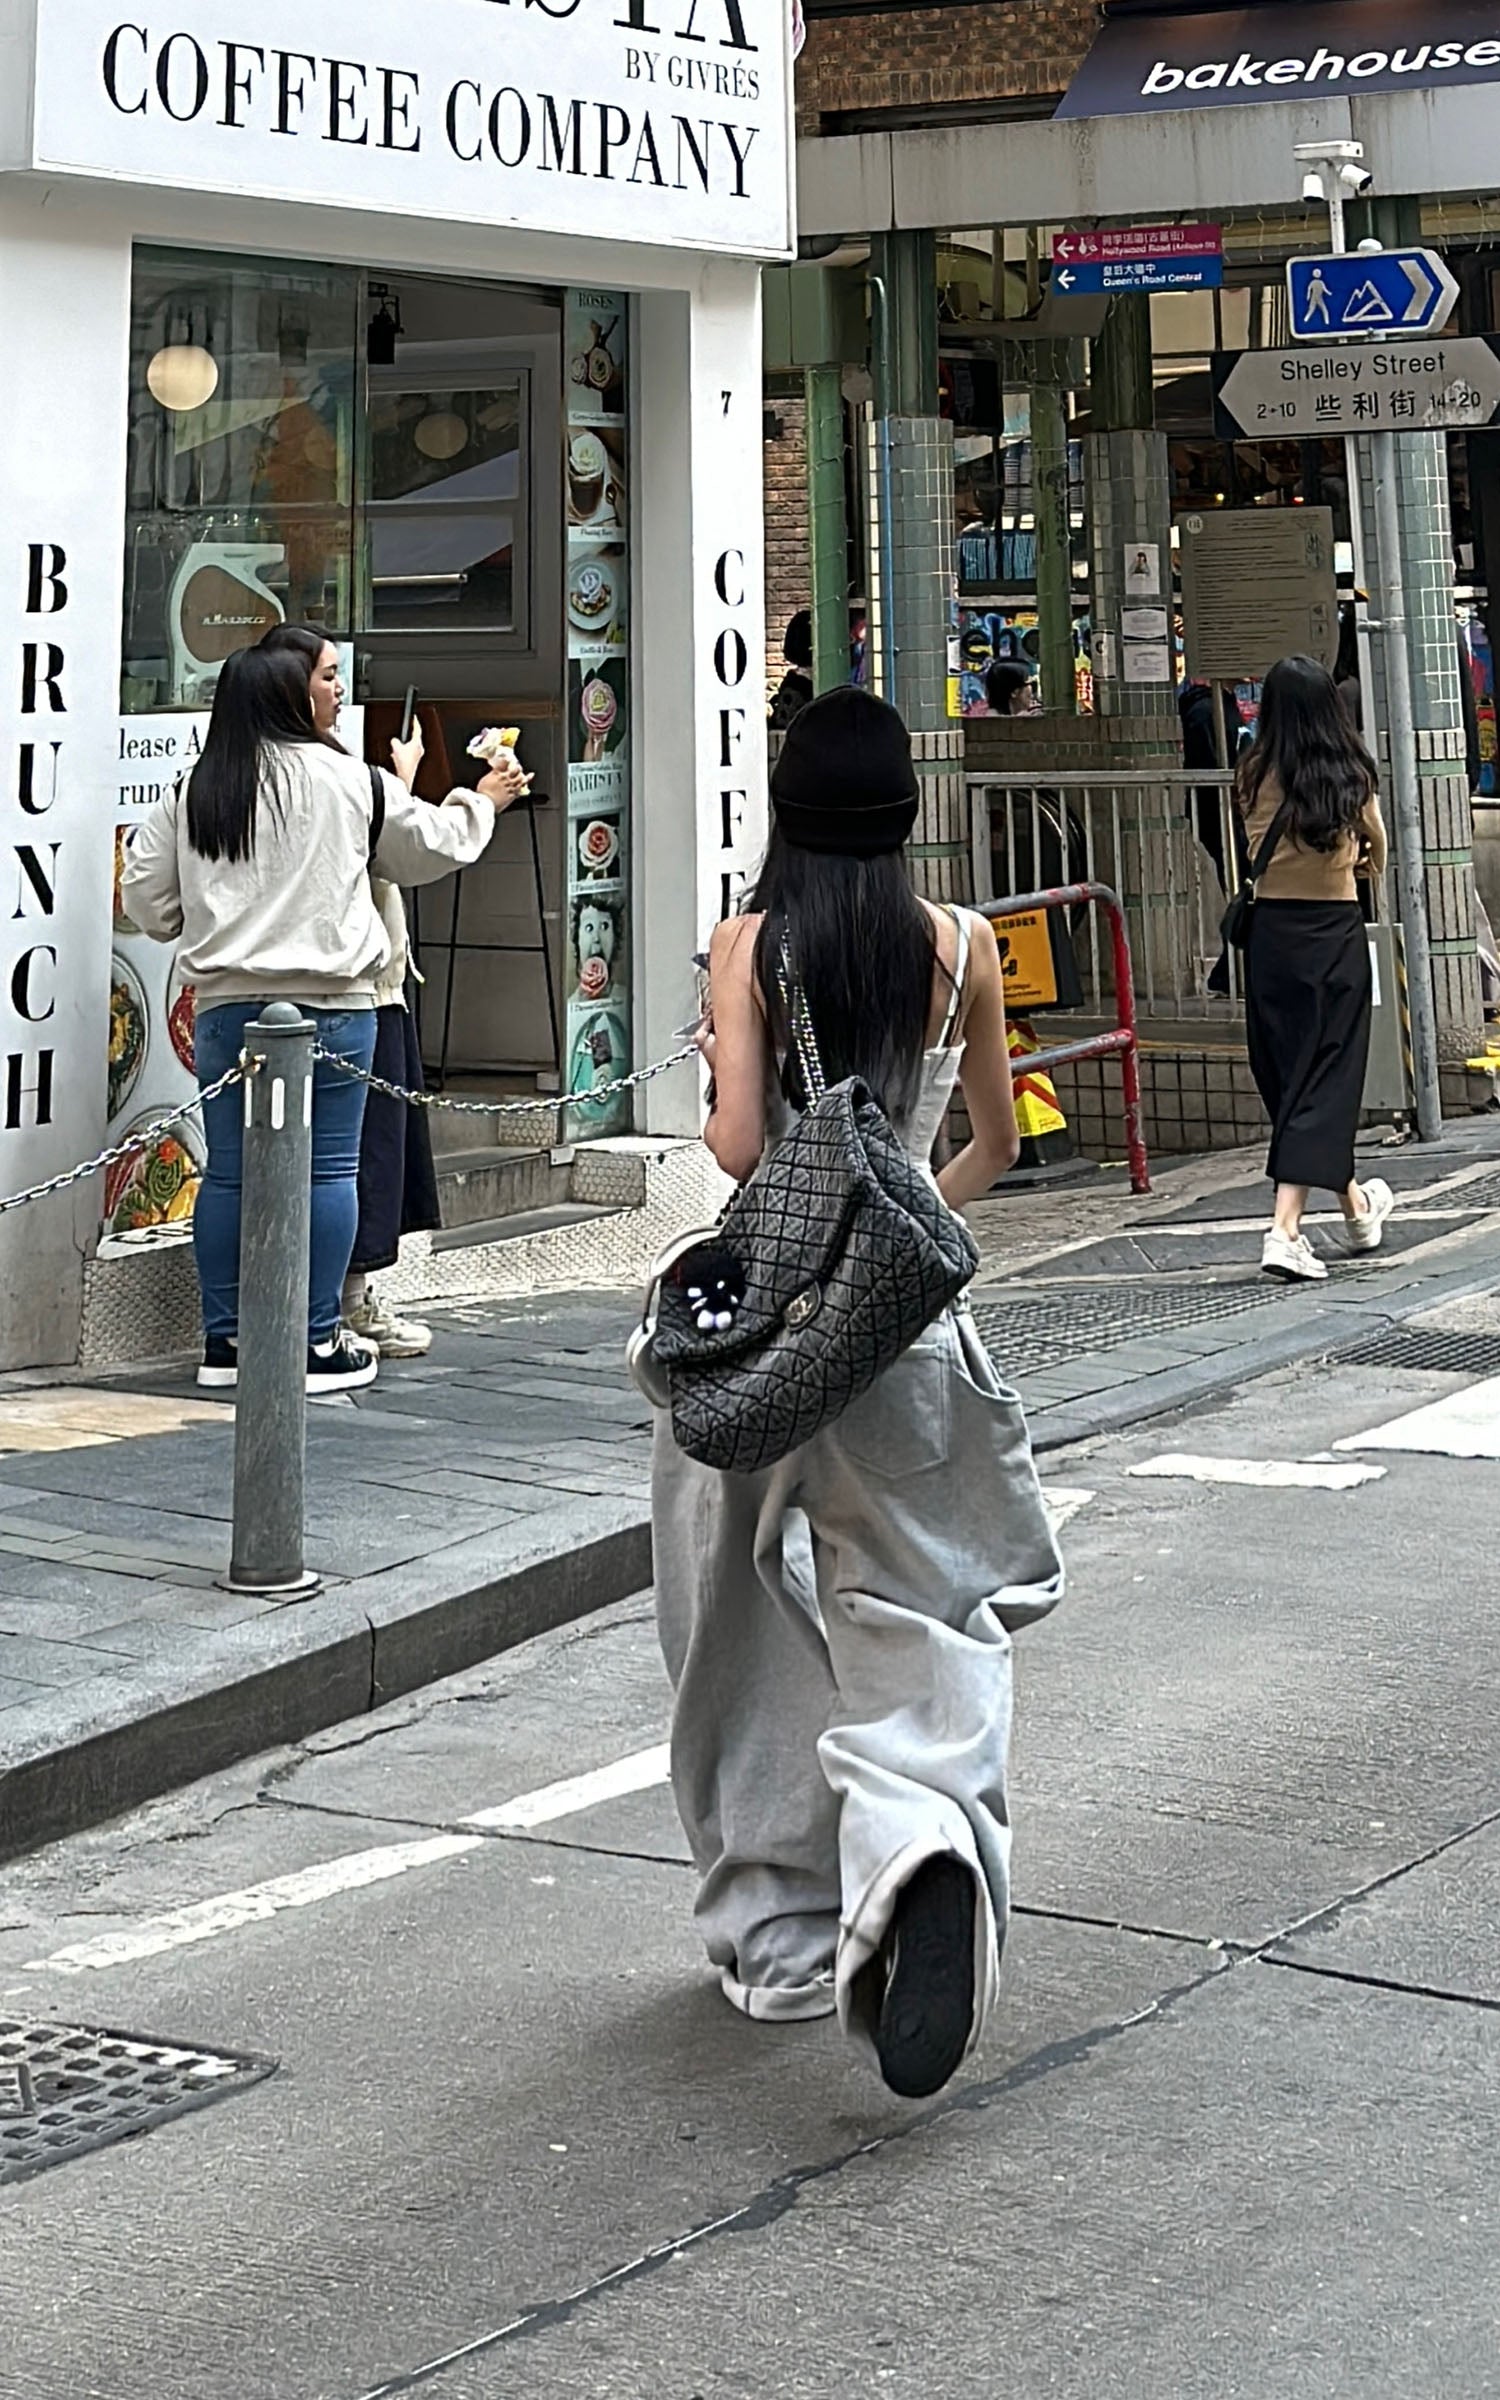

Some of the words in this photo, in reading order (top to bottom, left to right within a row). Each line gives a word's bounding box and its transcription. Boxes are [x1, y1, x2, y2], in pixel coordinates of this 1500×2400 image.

[625, 48, 660, 83] BY
[668, 58, 760, 100] GIVRÉS
[1141, 39, 1500, 95] bakehouse
[102, 23, 421, 153] COFFEE
[445, 79, 760, 198] COMPANY
[1103, 275, 1140, 287] Queen's
[1142, 274, 1166, 284] Road
[1168, 272, 1202, 283] Central
[1280, 359, 1362, 381] Shelley
[1373, 351, 1446, 376] Street
[720, 390, 732, 415] 7
[1256, 402, 1296, 419] 2-10
[1315, 390, 1415, 422] 些利街
[1430, 391, 1481, 410] 14-20
[4, 543, 68, 1129] BRUNCH
